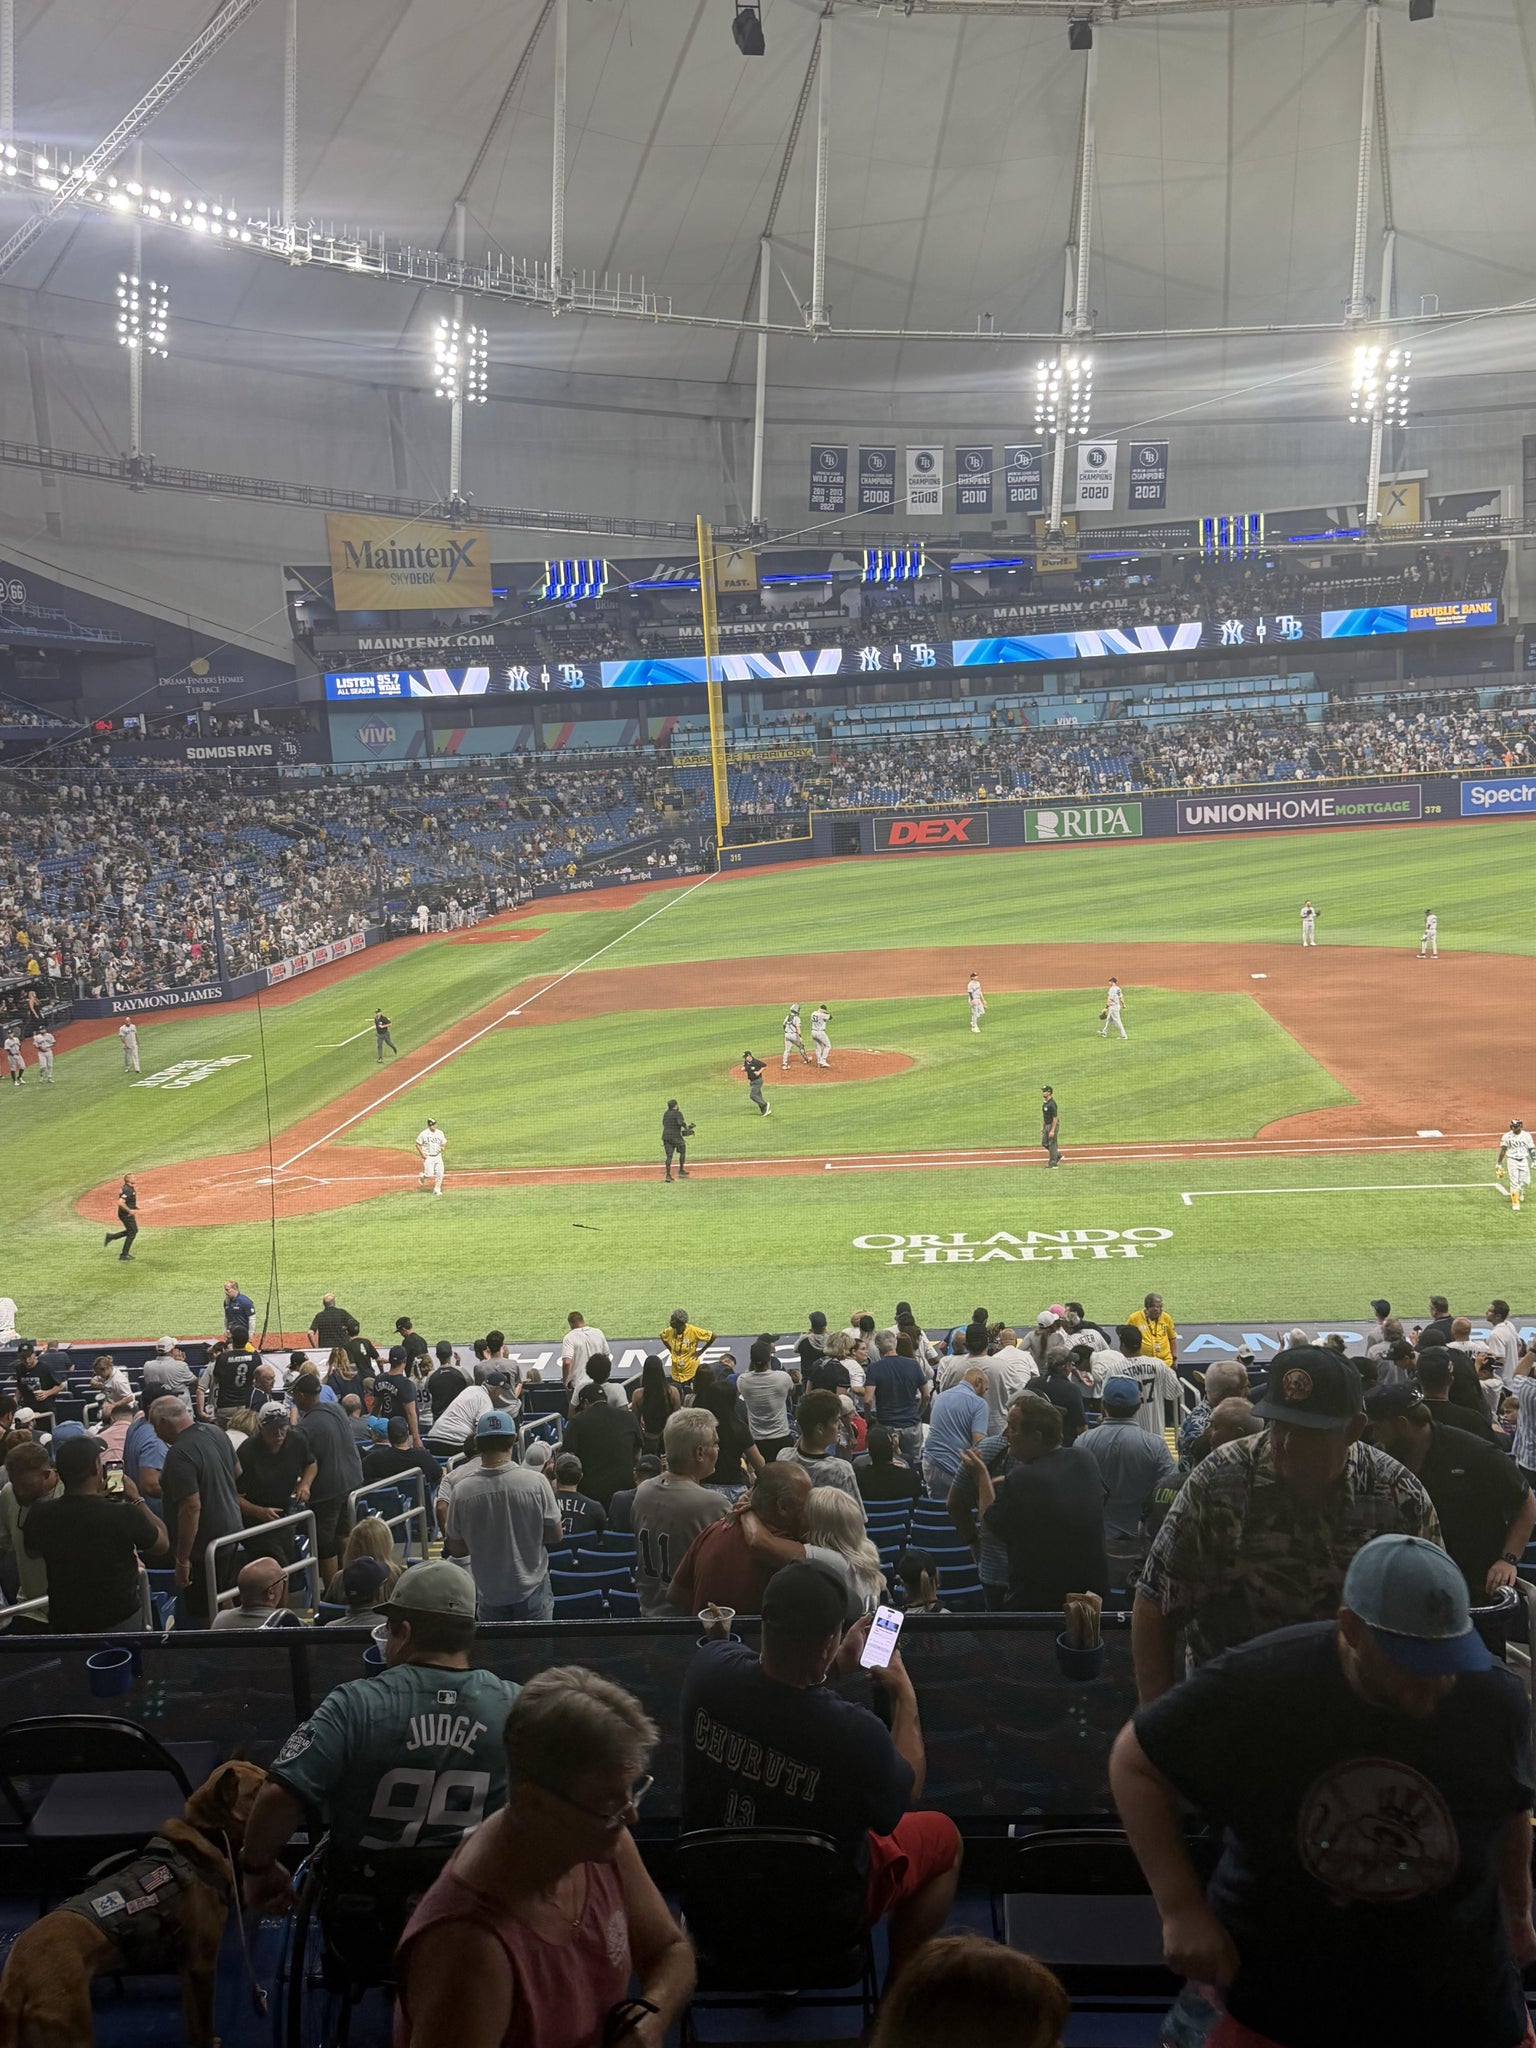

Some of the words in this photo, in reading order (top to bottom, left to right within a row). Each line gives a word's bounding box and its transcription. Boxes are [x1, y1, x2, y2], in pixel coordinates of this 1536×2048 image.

[1008, 475, 1040, 483] CHAMPIONS
[1080, 473, 1112, 481] CHAMPIONS
[1131, 472, 1164, 481] CHAMPIONS
[863, 490, 889, 502] 2008
[911, 491, 938, 503] 2008
[962, 491, 986, 503] 2010
[1011, 489, 1038, 501] 2020
[1082, 487, 1108, 499] 2020
[1135, 486, 1160, 498] 2021
[341, 538, 477, 582] MaintenX
[390, 572, 436, 585] SKYDECK
[10, 585, 24, 600] 66
[993, 598, 1129, 618] MAINTENXCOM
[1410, 605, 1461, 619] REPUBLIC
[1461, 602, 1493, 615] BANK
[187, 676, 217, 685] FINDERS
[217, 675, 244, 684] HOMES
[336, 676, 375, 689] LISTEN
[376, 673, 400, 685] 95.7
[185, 685, 220, 694] TERRACE
[358, 726, 397, 743] VIVA
[186, 746, 237, 760] SOMOS
[237, 744, 273, 757] RAYS
[677, 756, 712, 765] TARPS
[749, 749, 811, 761] TERRITORY
[1470, 784, 1536, 809] Spectr
[1335, 800, 1411, 816] MORTGAGE
[1424, 805, 1441, 815] 378
[1060, 805, 1134, 838] RIPA
[888, 817, 974, 846] DEX
[111, 993, 180, 1013] RAYMOND
[180, 987, 223, 1003] JAMES
[852, 1226, 1174, 1249] ORLANDO
[885, 1243, 1145, 1266] HEALTH
[359, 1342, 368, 1356] 4
[1122, 1364, 1156, 1377] STANTON
[638, 1527, 673, 1584] 11
[405, 1713, 488, 1756] JUDGE
[694, 1707, 820, 1802] CHURUTI
[358, 1767, 492, 1850] 99
[724, 1789, 756, 1828] 13
